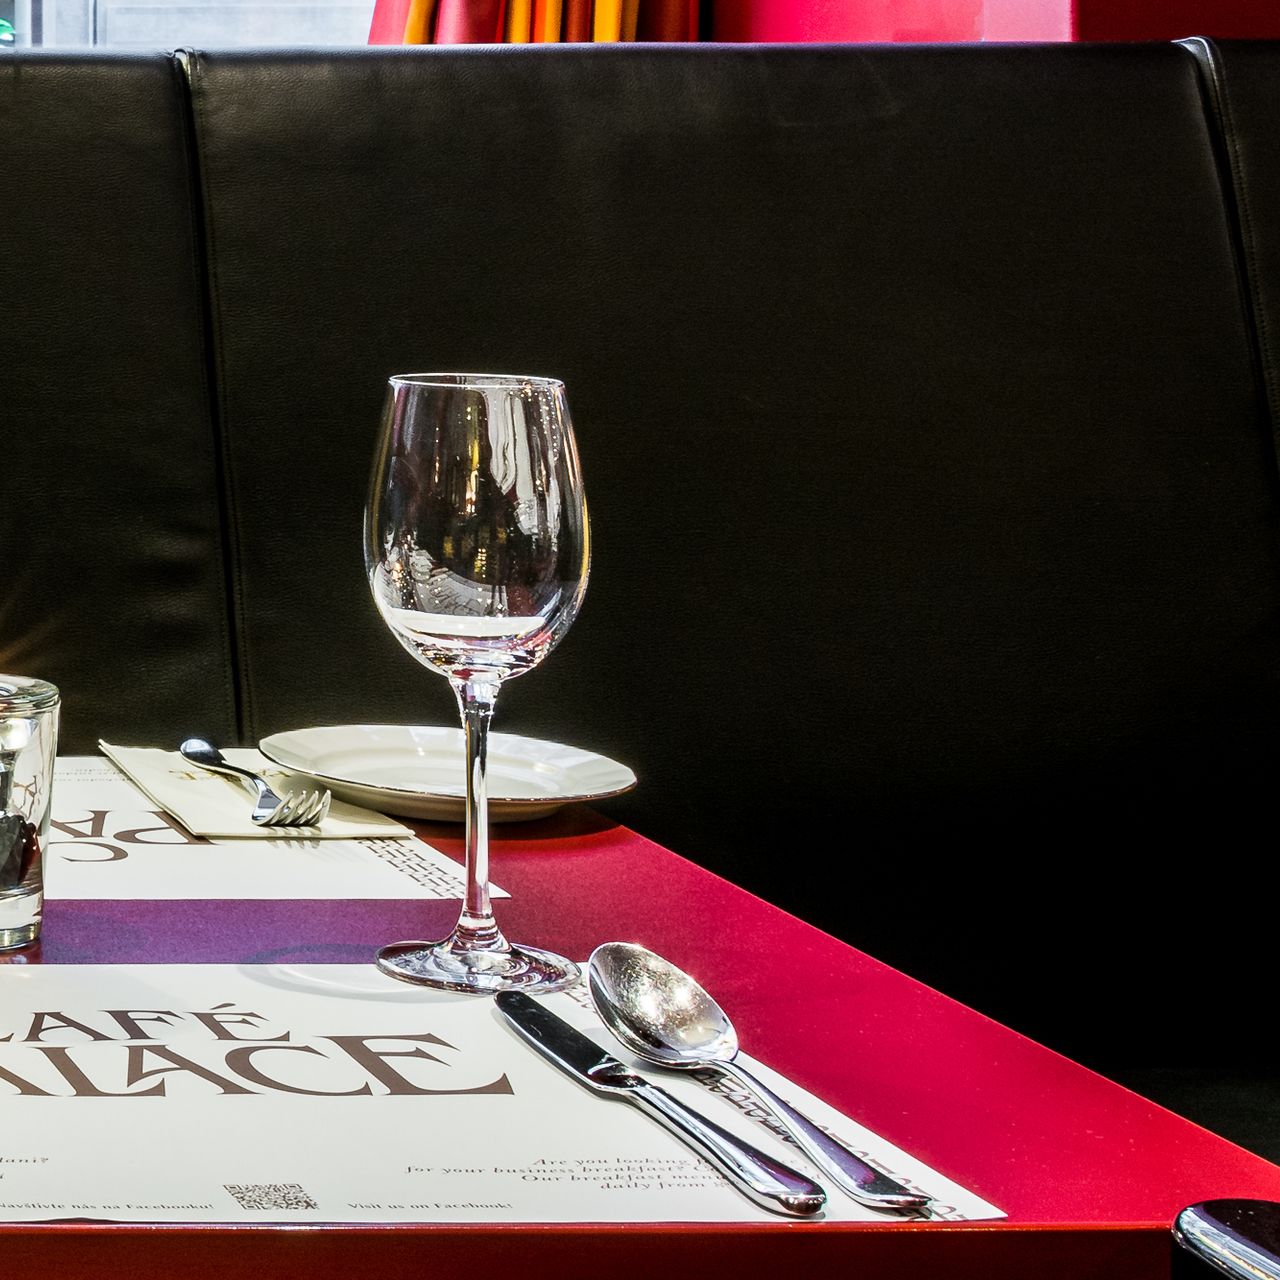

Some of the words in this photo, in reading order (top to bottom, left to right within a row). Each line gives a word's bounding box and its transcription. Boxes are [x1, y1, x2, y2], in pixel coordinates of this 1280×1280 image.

[533, 1158, 567, 1166] Are
[403, 1166, 433, 1174] for
[441, 1167, 486, 1175] your
[493, 1166, 575, 1174] business
[571, 1173, 662, 1182] breakfast
[600, 1182, 651, 1190] daily
[658, 1181, 706, 1190] from
